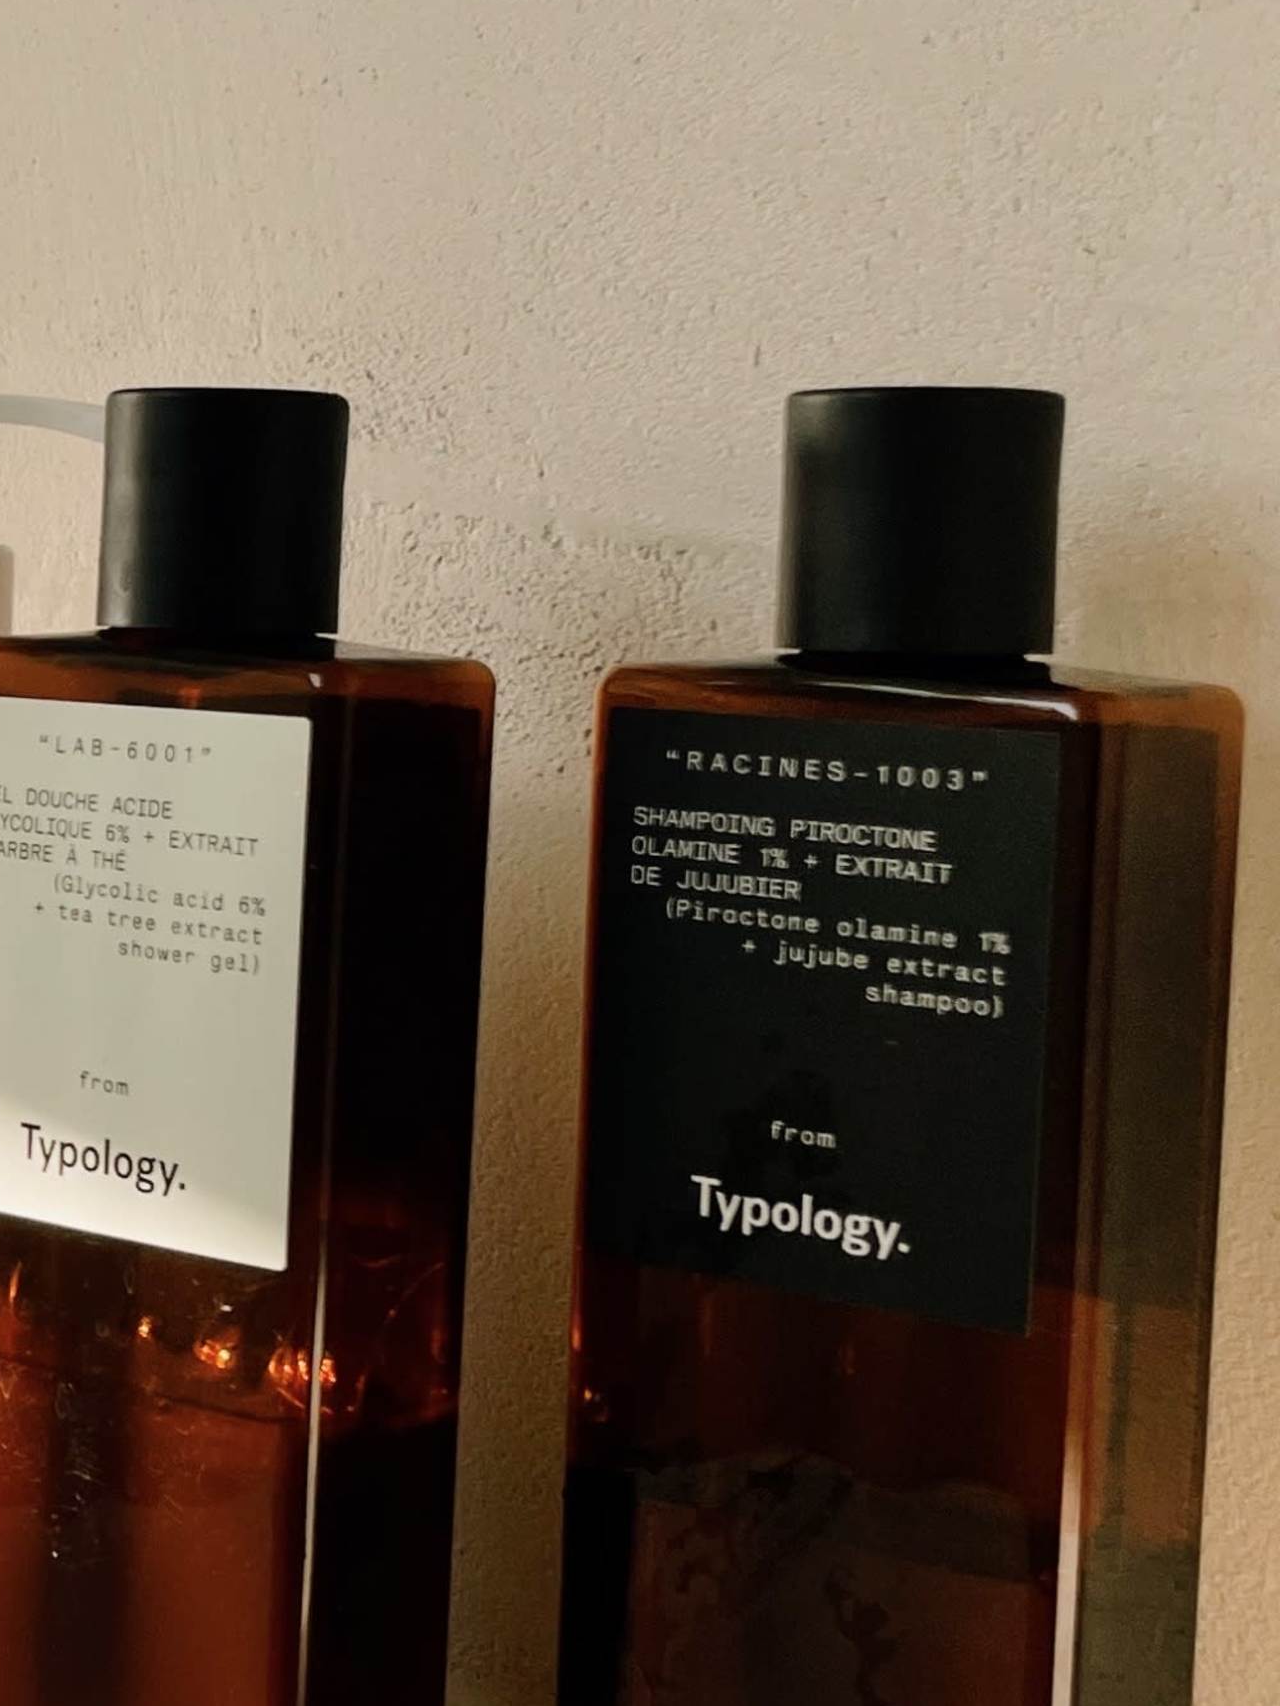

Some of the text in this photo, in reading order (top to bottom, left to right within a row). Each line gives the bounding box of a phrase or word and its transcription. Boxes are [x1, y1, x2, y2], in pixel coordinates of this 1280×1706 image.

[665, 749, 990, 792] “RACINES-1003”
[24, 786, 100, 814] DOUCHE
[111, 796, 175, 821] ACIDE
[104, 824, 132, 845] 6%
[167, 830, 261, 858] EXTRAIT
[633, 805, 940, 853] SHAMPOING PIROCTONE
[65, 842, 80, 867] À
[631, 834, 955, 887] OLAMINE 1% + EXTRAIT
[53, 873, 267, 918] (Glycolic acid 6%
[630, 864, 803, 902] DE JUJUBIER
[59, 904, 94, 925] tea
[107, 910, 157, 933] tree
[170, 920, 263, 947] extract
[665, 896, 1013, 955] (Piroctone olamine 1%
[117, 939, 261, 977] shower gel)
[741, 938, 1007, 988] + jujube extract
[864, 982, 1004, 1020] shampoo)
[79, 1069, 130, 1097] from
[769, 1119, 838, 1150] from
[19, 1121, 187, 1198] Typology.
[689, 1173, 912, 1261] Typology.
